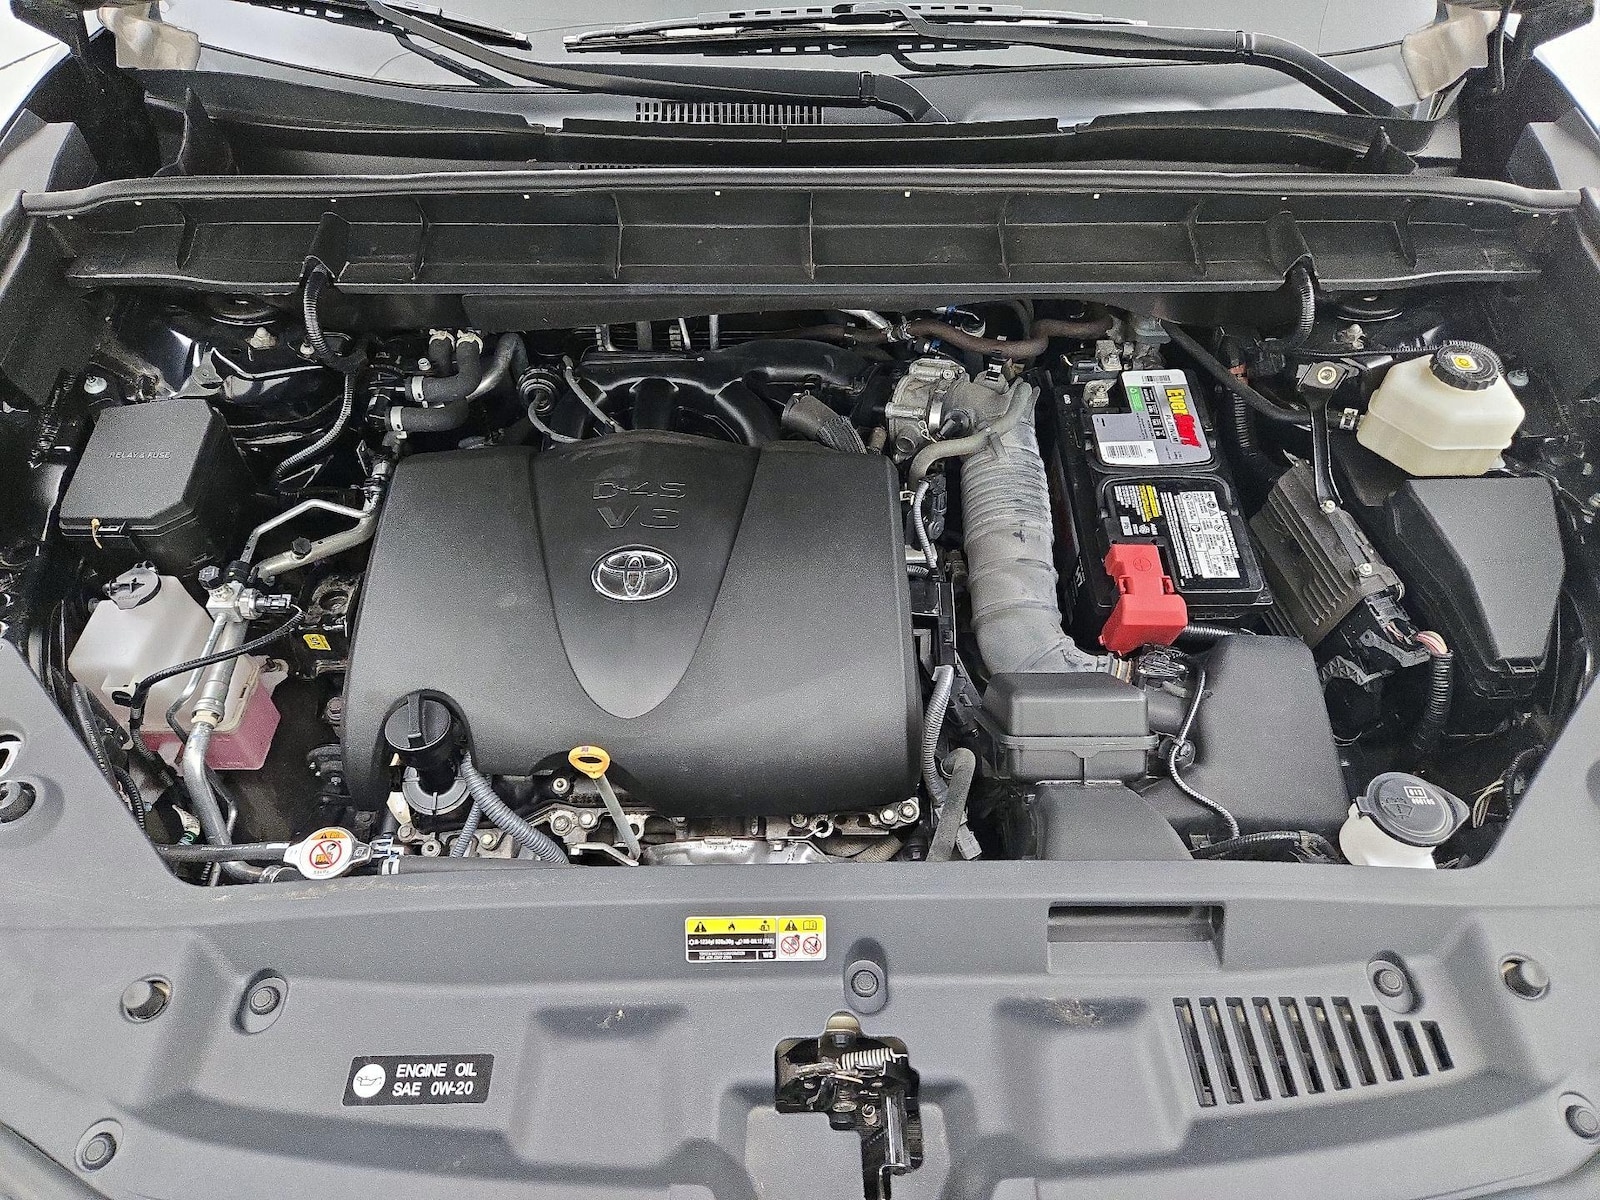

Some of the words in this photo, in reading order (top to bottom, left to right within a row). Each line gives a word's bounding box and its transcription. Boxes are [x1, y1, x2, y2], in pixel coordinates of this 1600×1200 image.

[1164, 414, 1179, 443] PLATINUM
[108, 451, 139, 459] RELAY
[147, 451, 172, 459] FUSE
[396, 1063, 447, 1077] ENGINE
[455, 1062, 478, 1077] OIL
[392, 1082, 421, 1096] SAE
[430, 1080, 474, 1095] 0W-20
